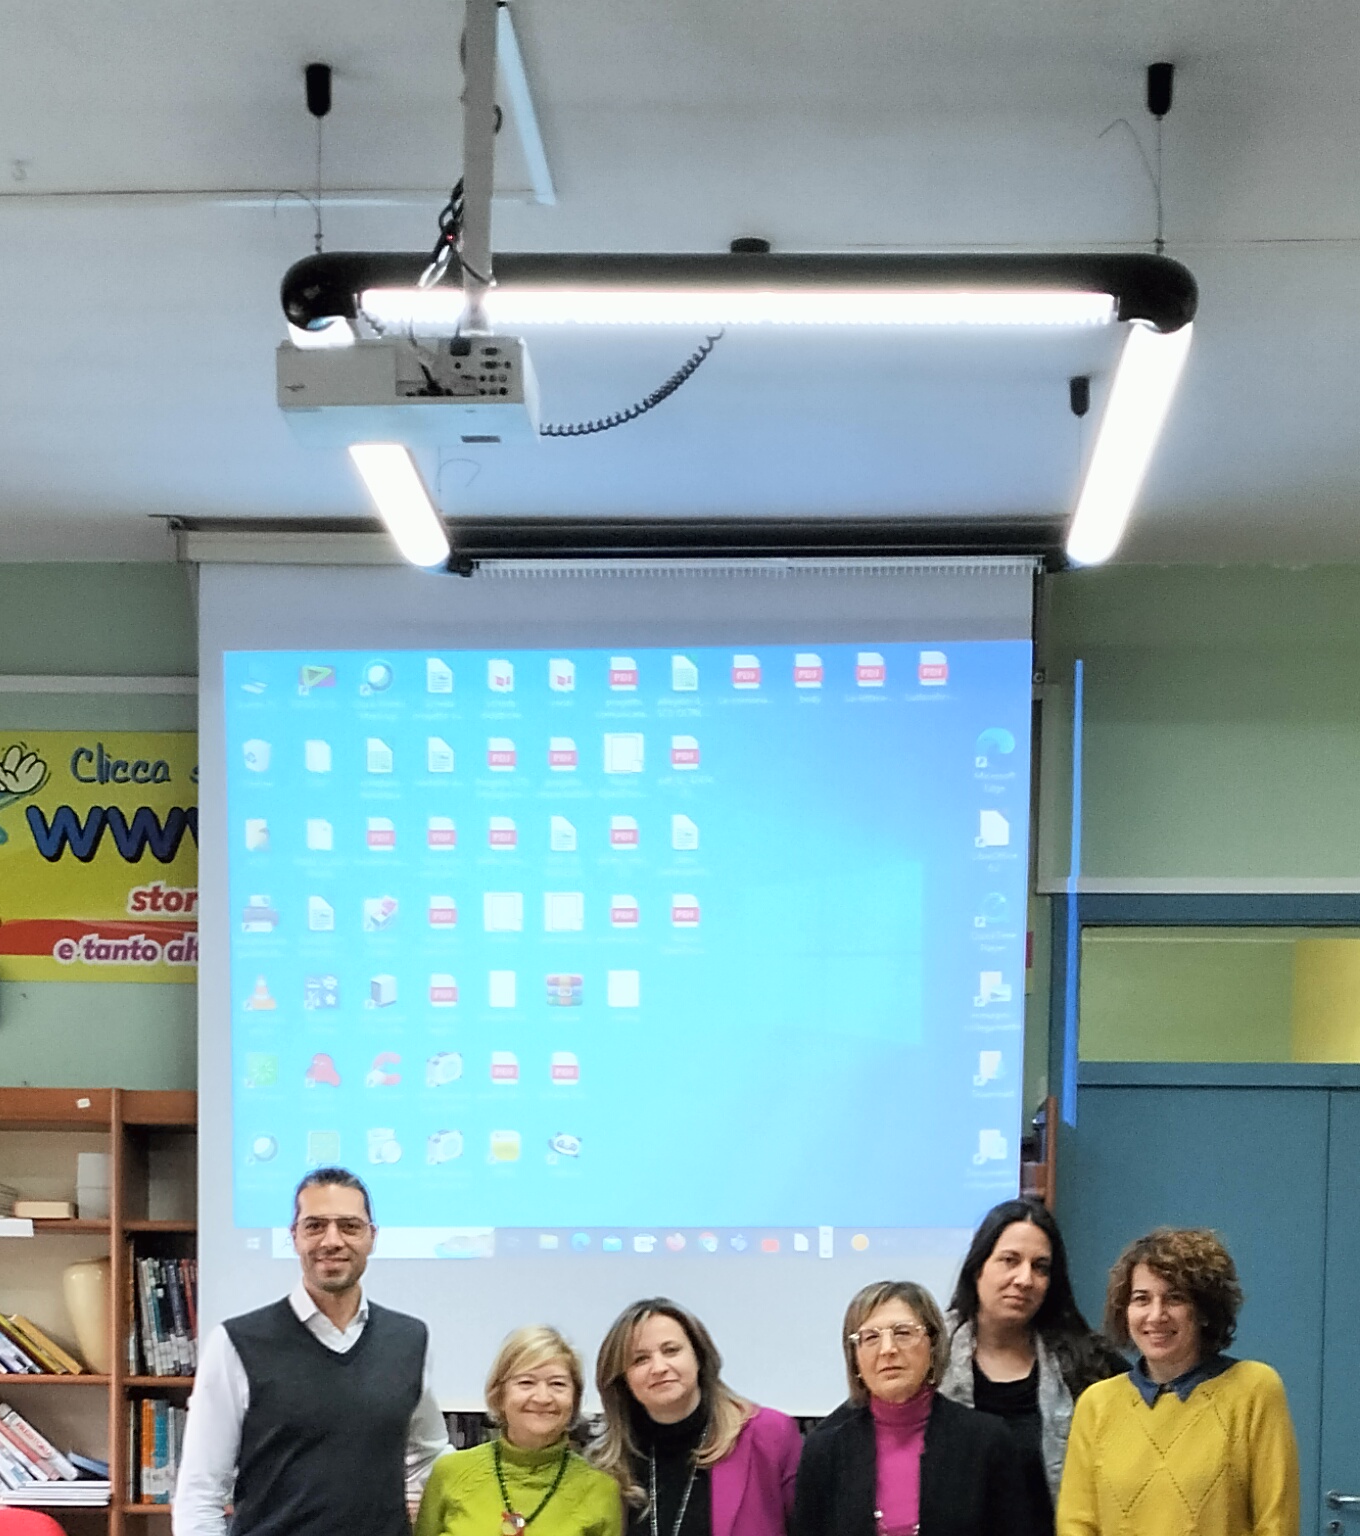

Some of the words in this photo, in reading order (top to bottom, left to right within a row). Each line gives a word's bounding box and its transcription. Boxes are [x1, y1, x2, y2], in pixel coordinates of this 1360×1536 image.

[70, 742, 171, 784] Clicca
[58, 943, 74, 960] e
[83, 939, 158, 961] tanto
